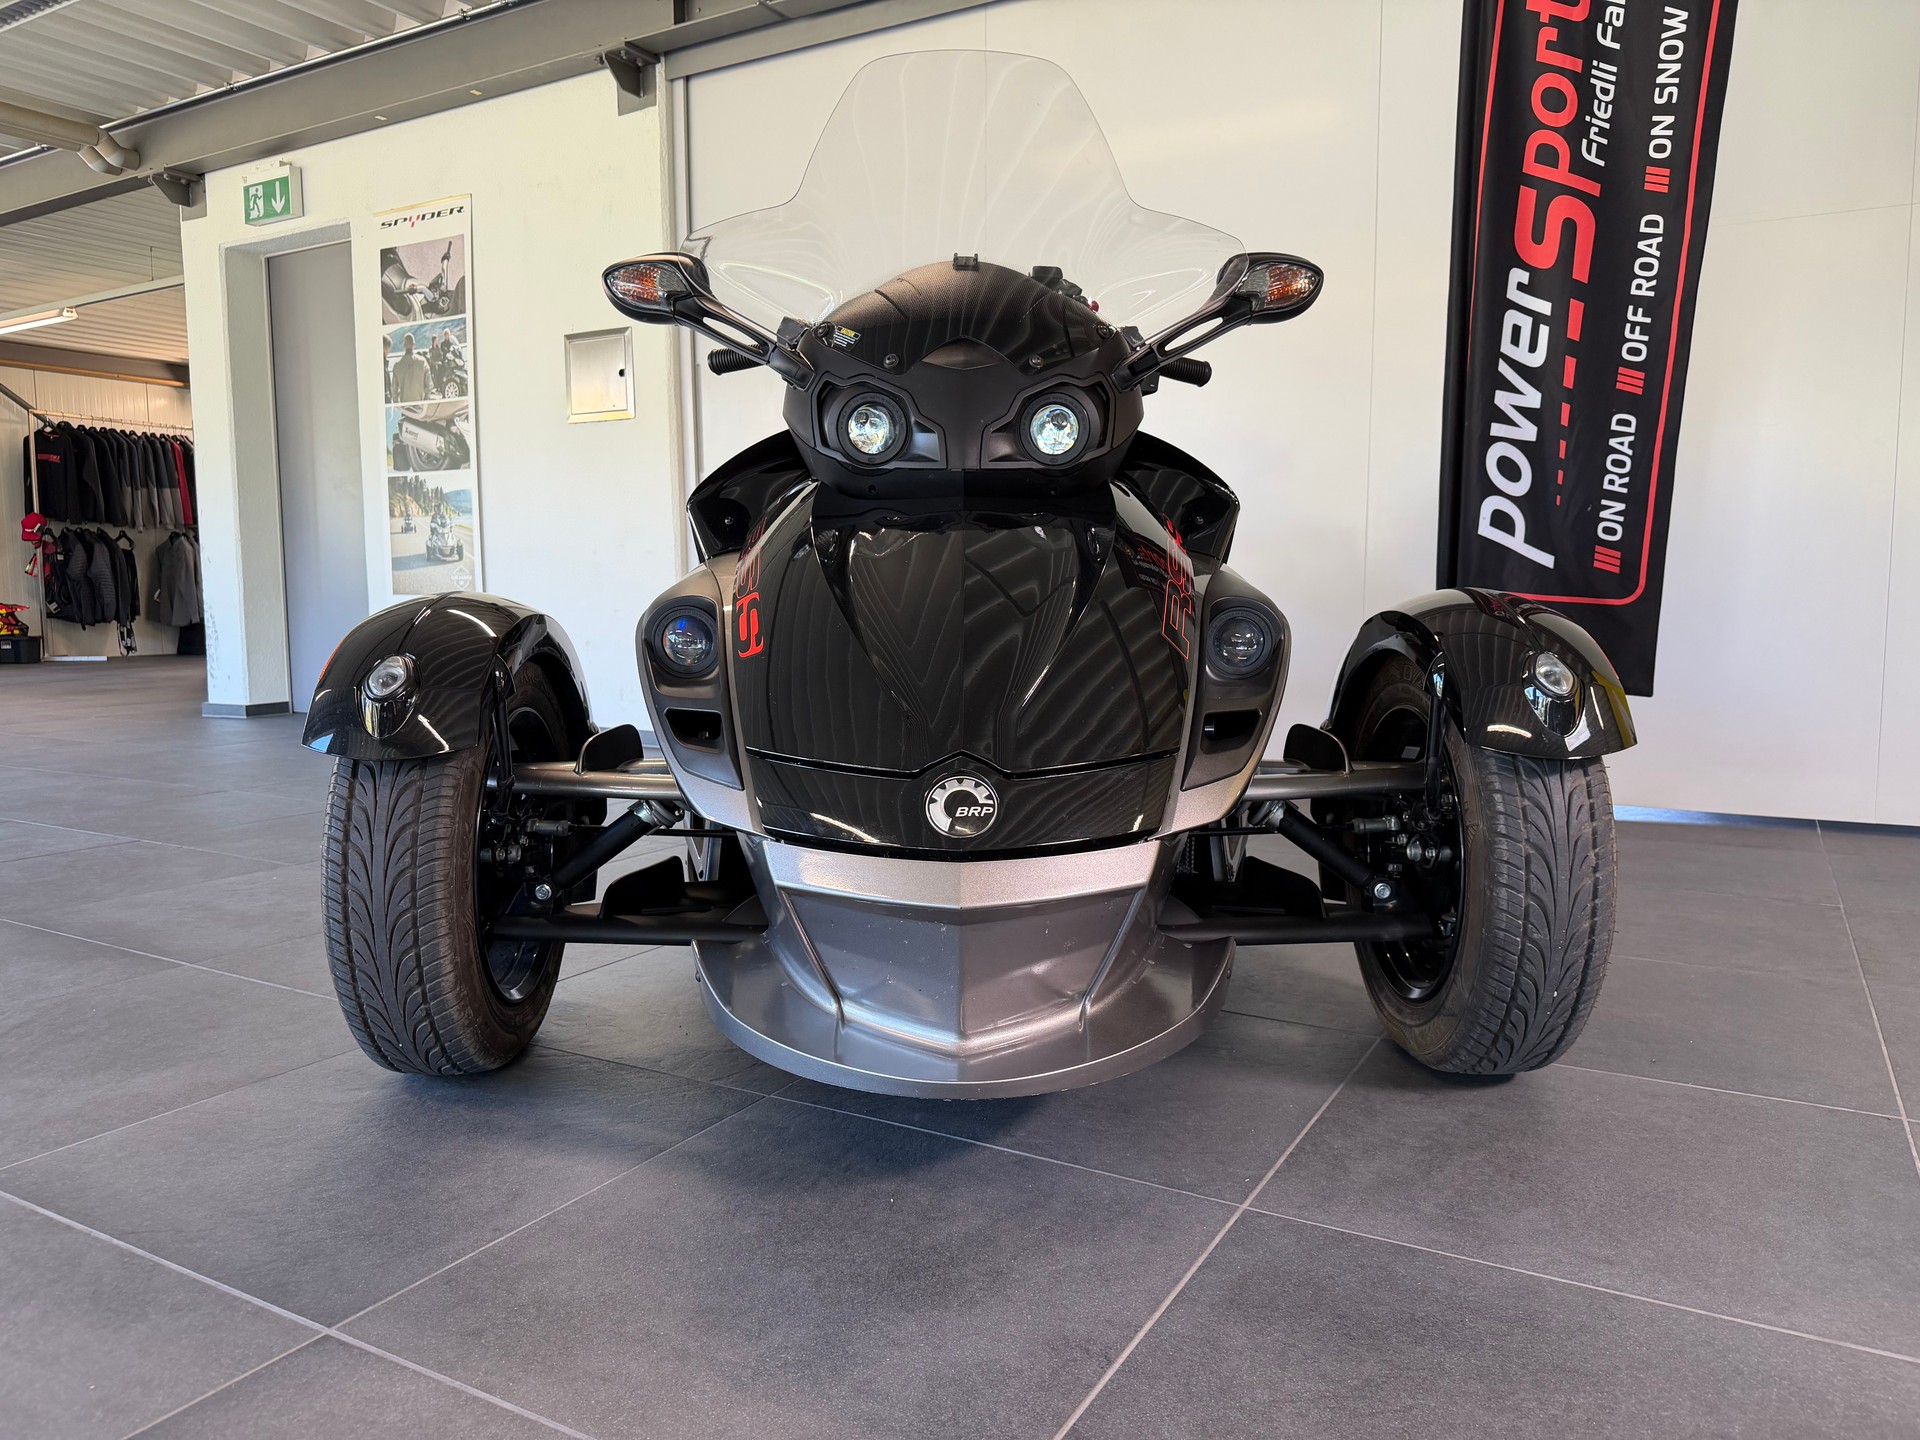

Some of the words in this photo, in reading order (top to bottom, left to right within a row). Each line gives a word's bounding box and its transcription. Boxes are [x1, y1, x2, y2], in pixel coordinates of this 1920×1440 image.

[1653, 6, 1689, 105] SNOW
[1581, 60, 1618, 167] Friedli
[1648, 115, 1675, 159] ON
[380, 205, 464, 229] SPYDER
[1630, 213, 1665, 297] ROAD
[1621, 305, 1652, 362] OFF
[1602, 413, 1637, 494] ROAD
[1597, 499, 1626, 542] ON
[955, 806, 994, 817] BRP
